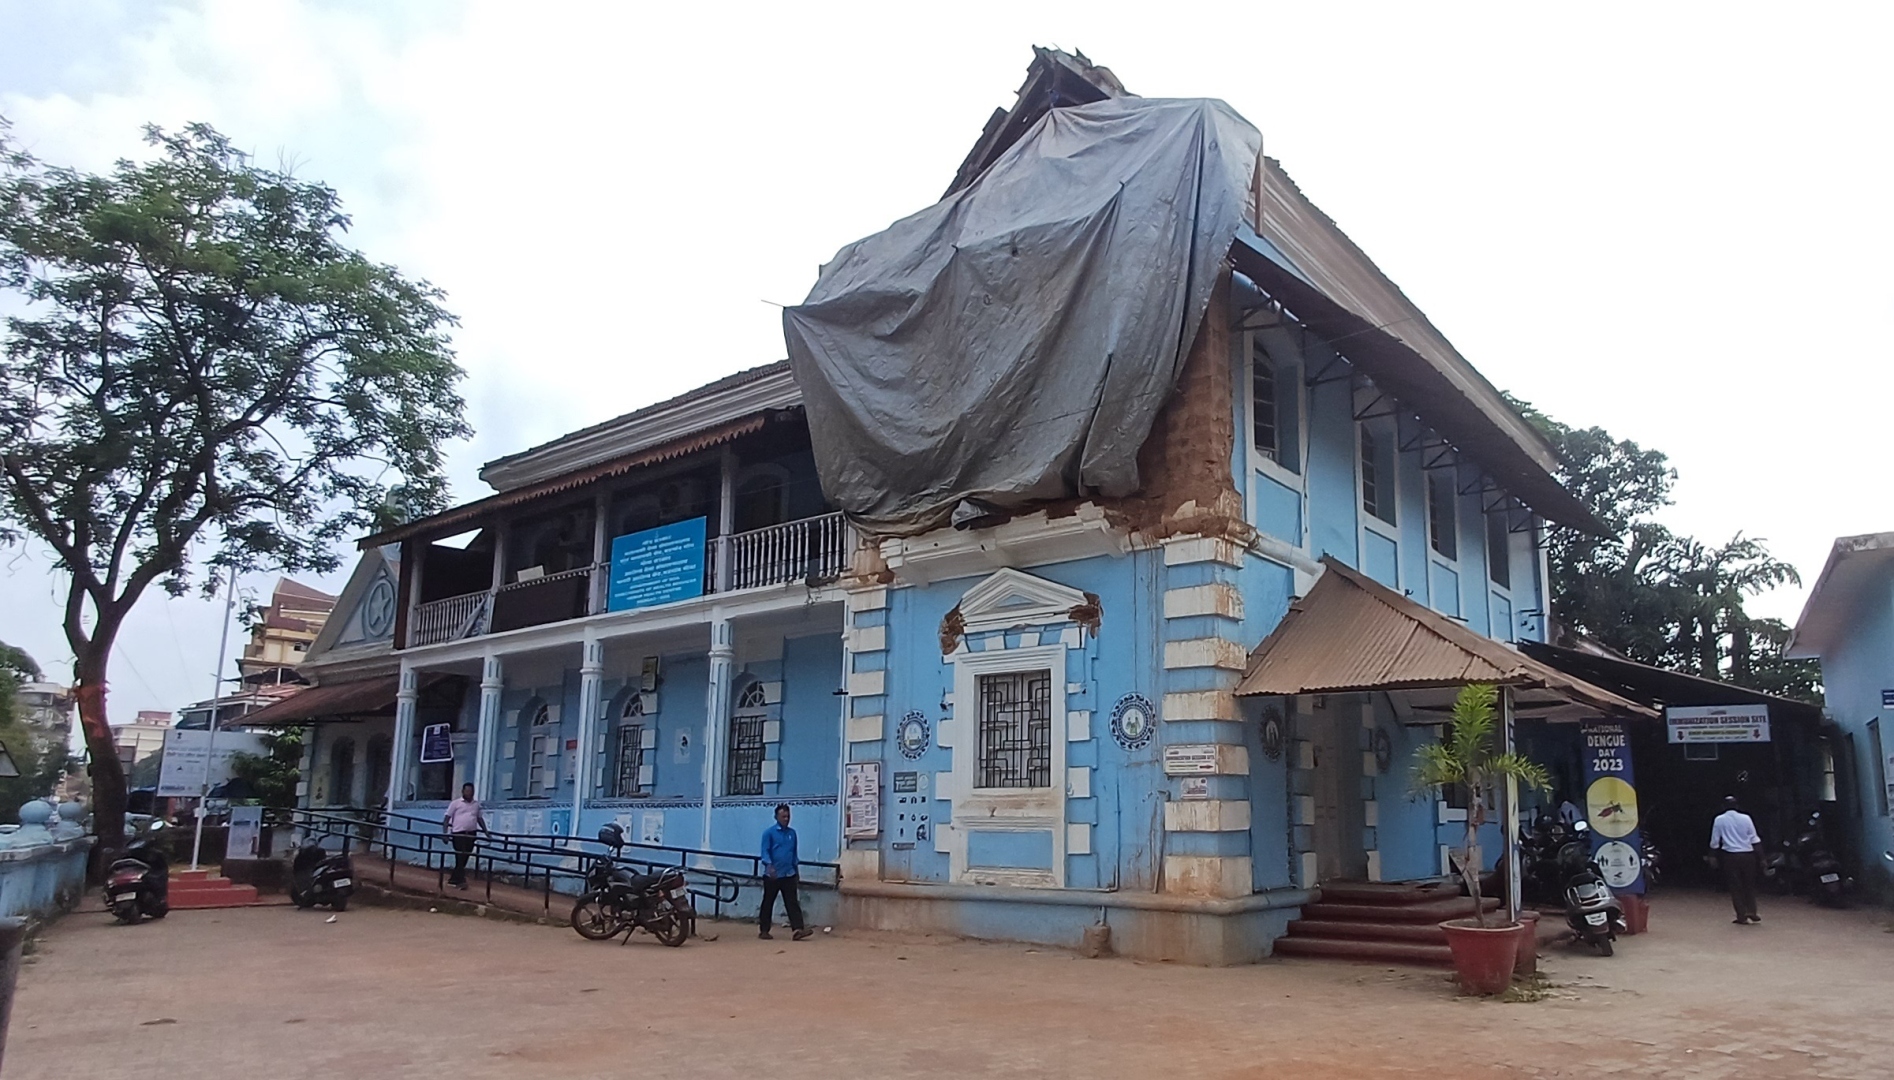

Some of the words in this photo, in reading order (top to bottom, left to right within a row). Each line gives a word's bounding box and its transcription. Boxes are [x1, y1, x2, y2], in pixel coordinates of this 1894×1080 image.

[1720, 715, 1750, 725] SESSION
[1751, 715, 1767, 723] SITE
[1587, 734, 1626, 747] DENGUE
[1598, 748, 1616, 758] DAY
[1592, 758, 1624, 772] 2023
